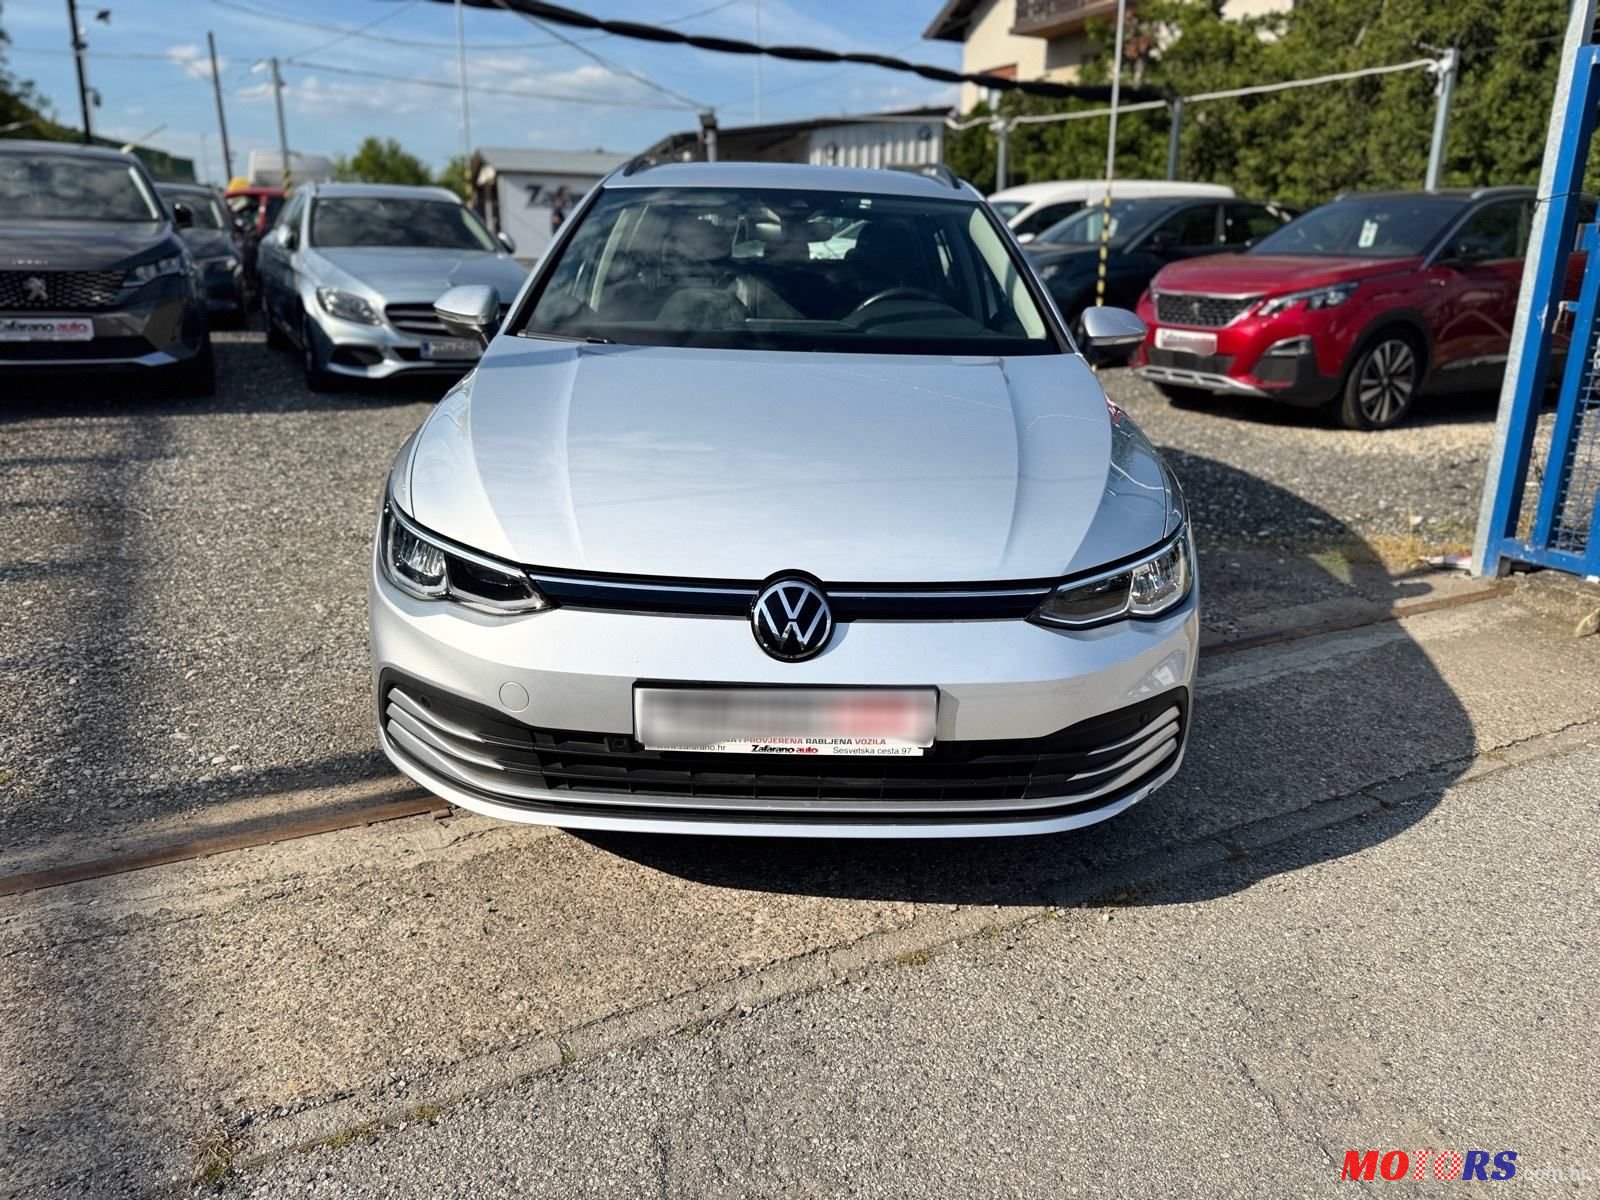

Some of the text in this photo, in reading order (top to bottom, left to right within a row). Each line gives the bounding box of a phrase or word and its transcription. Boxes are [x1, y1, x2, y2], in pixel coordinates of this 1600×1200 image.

[744, 737, 803, 745] PROVJERENA
[805, 738, 853, 746] RABLJENA
[751, 744, 819, 754] Zafarano auto
[833, 746, 912, 755] Sesvetska cesta 97
